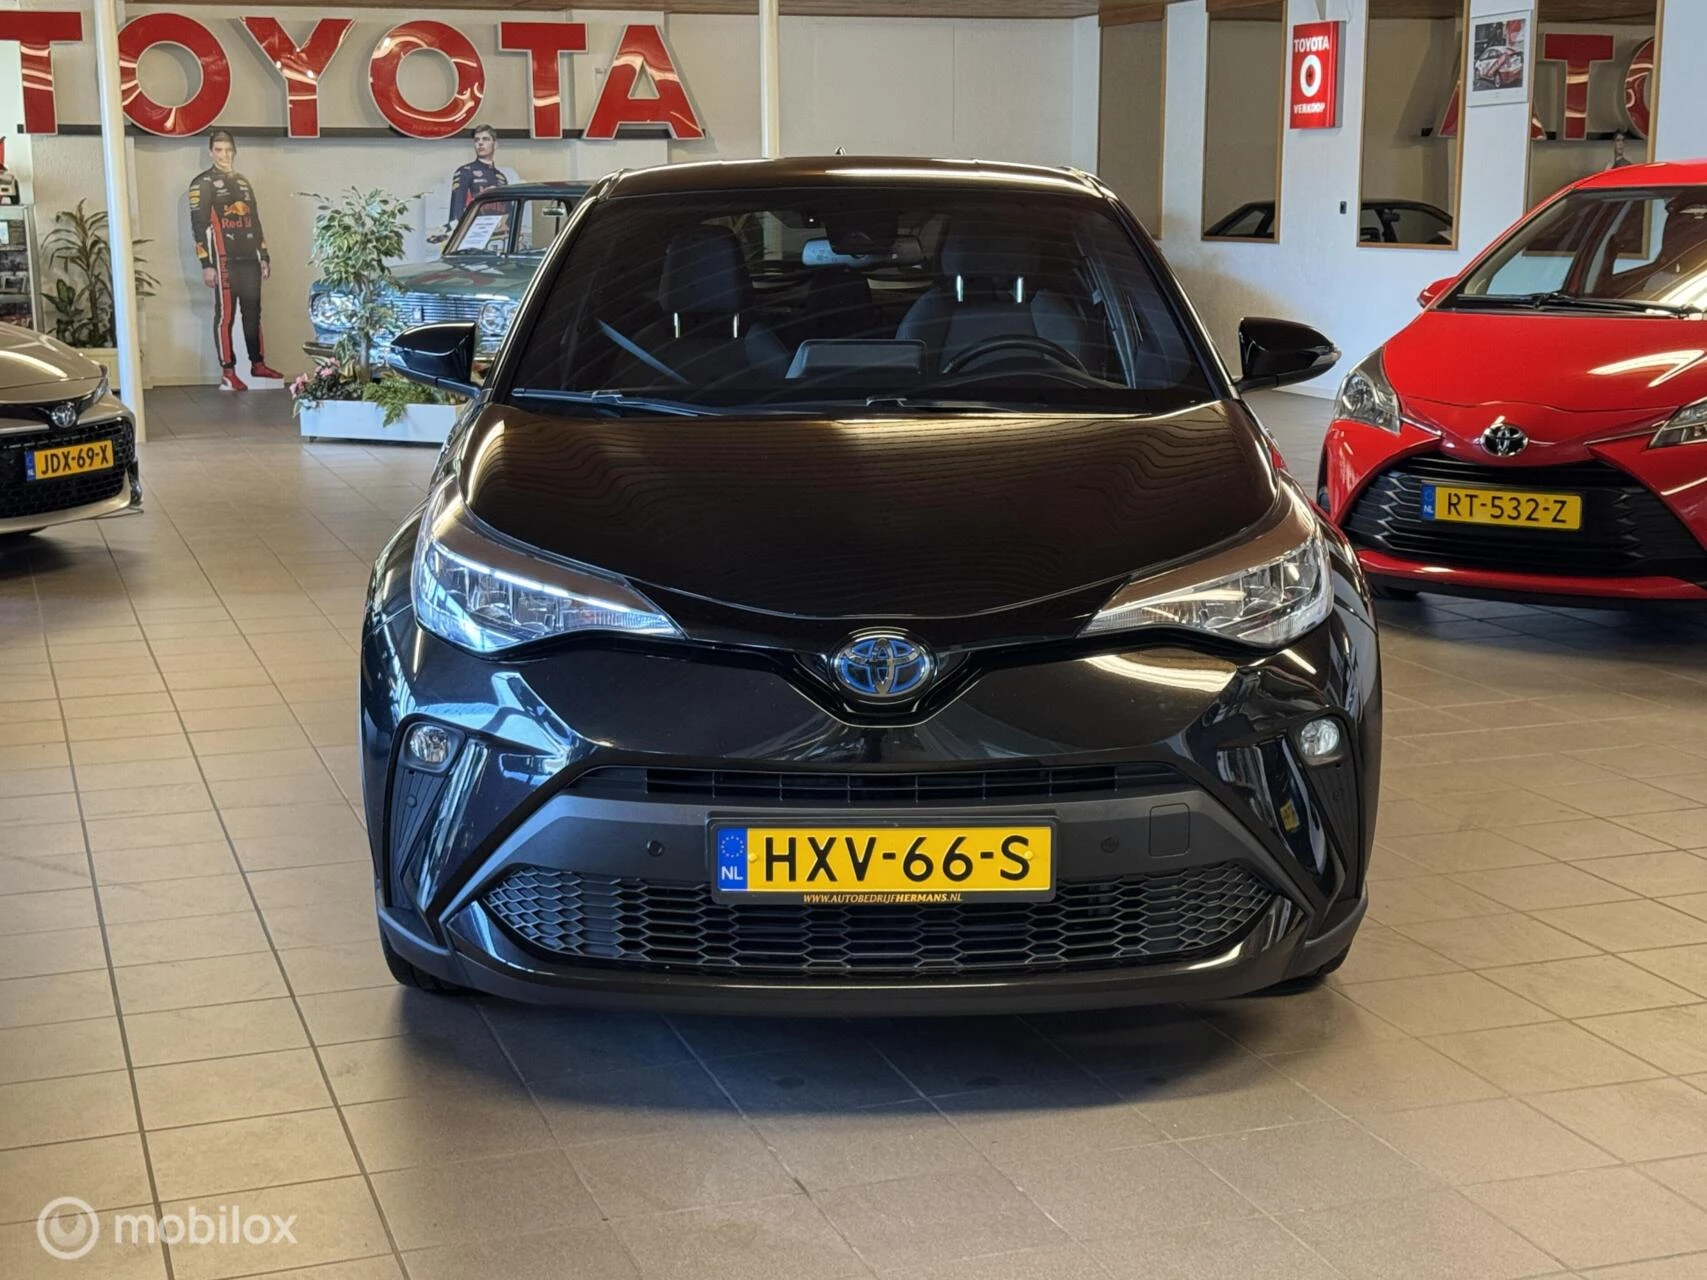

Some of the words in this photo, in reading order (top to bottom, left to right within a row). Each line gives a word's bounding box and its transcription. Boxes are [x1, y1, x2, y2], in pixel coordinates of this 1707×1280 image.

[1294, 36, 1330, 53] TOYOTA
[0, 10, 706, 140] TOYOTA
[1293, 102, 1326, 114] VERKOOP
[41, 444, 109, 475] JDX-69-X
[1423, 504, 1434, 514] NL
[1447, 492, 1568, 524] RT-532-Z
[721, 867, 744, 881] NL
[764, 834, 1031, 882] HXV-66-S
[803, 893, 963, 904] WWW.AUTOBEDRIJFHERMANS.NL
